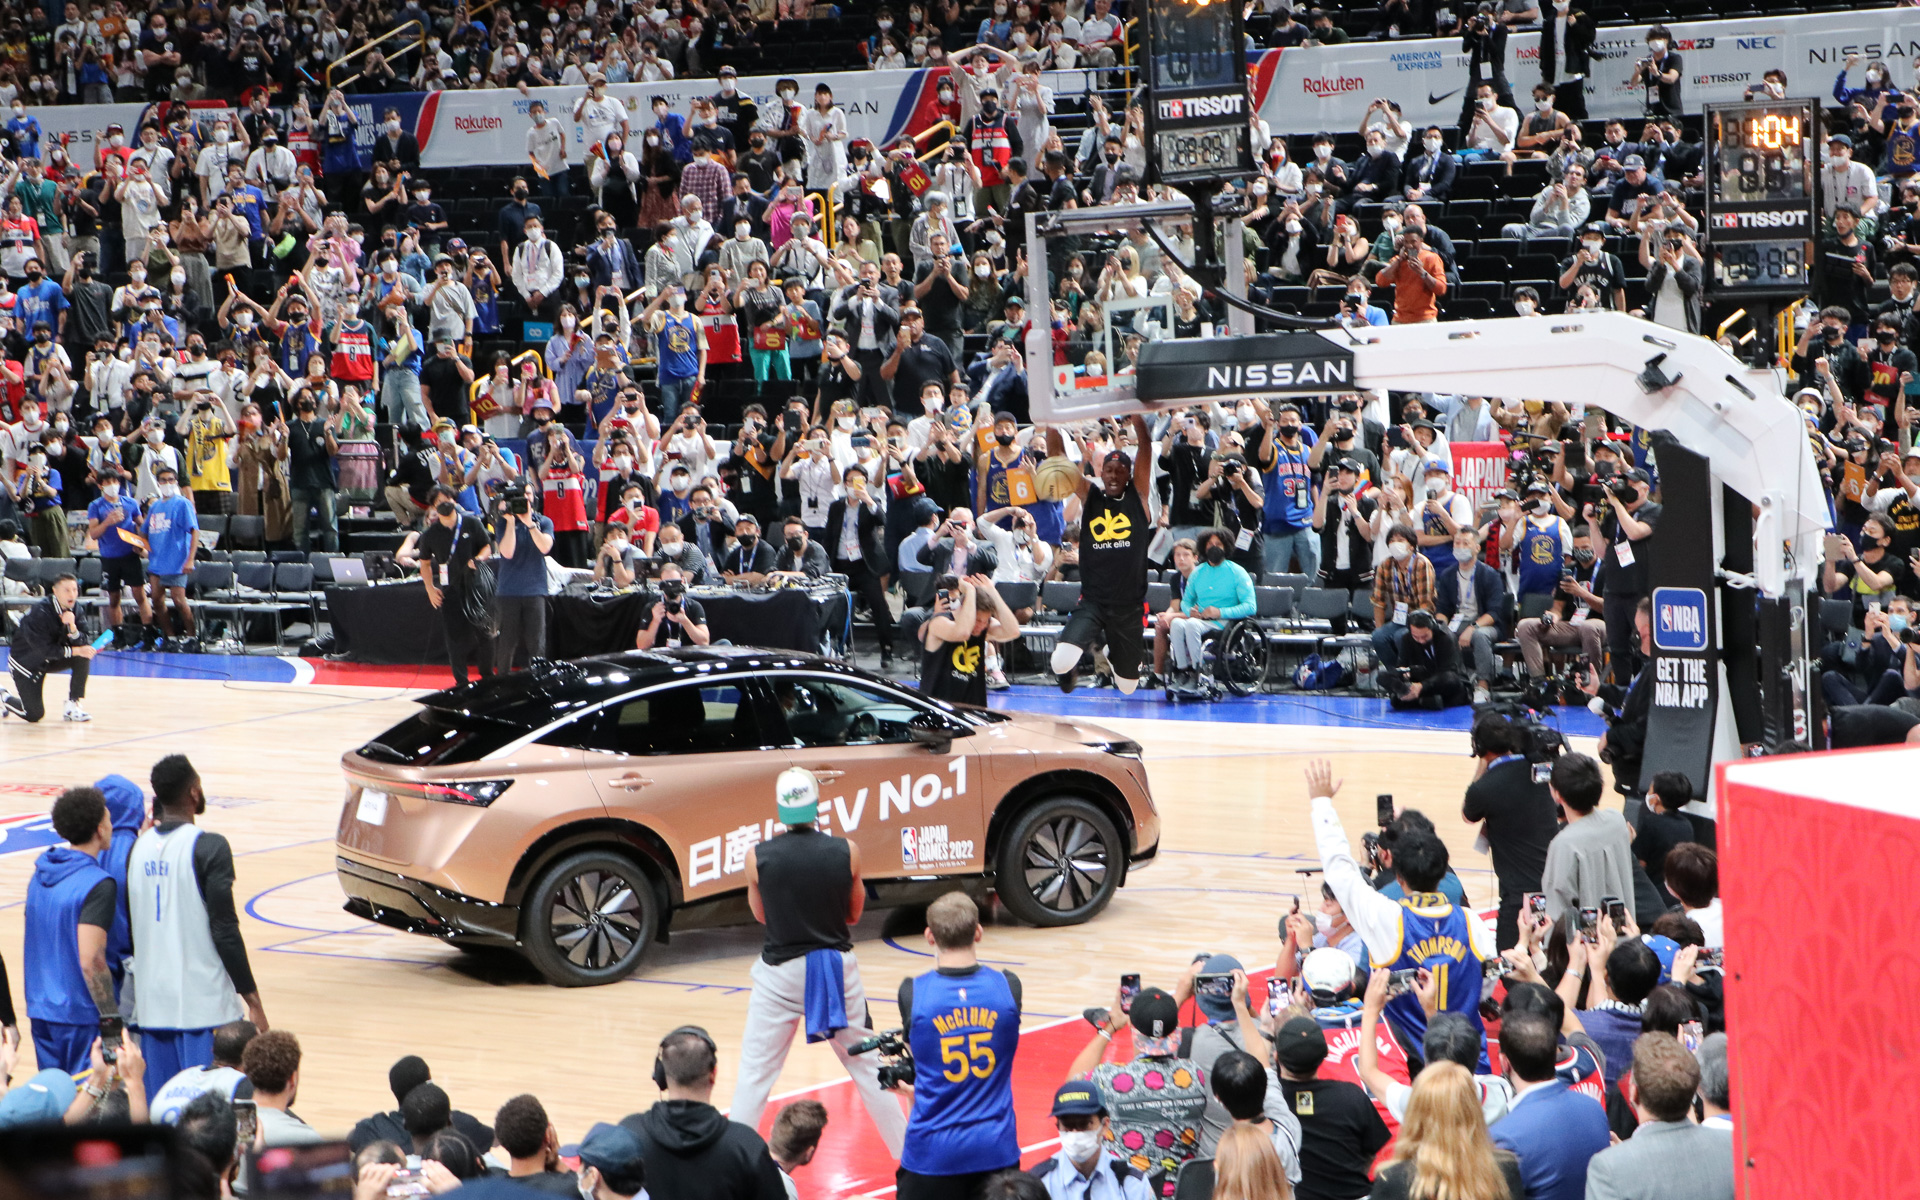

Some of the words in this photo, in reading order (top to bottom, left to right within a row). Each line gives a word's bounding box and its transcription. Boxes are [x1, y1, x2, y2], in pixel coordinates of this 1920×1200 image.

[1589, 39, 1637, 51] NSTYLE
[1736, 36, 1777, 50] NEC
[1390, 50, 1441, 62] AMERICAN
[1601, 50, 1628, 60] ROUP
[1397, 60, 1442, 72] EXPRESS
[1303, 75, 1364, 94] Rakuten
[1709, 72, 1752, 83] TISSOT
[1183, 93, 1244, 118] TISSOT
[454, 114, 503, 131] Rakuten
[1752, 115, 1800, 149] 1:04
[1737, 210, 1808, 228] TISSOT
[1208, 360, 1347, 389] NISSAN
[1455, 456, 1506, 488] JAPAN
[1015, 481, 1029, 499] 6
[1850, 477, 1861, 497] 6
[1089, 508, 1132, 542] de
[1092, 541, 1113, 550] dunk
[1113, 540, 1131, 549] elite
[1673, 604, 1701, 633] NBA
[1656, 656, 1680, 682] GET
[1681, 658, 1708, 684] THE
[1654, 681, 1681, 708] NBA
[1680, 683, 1709, 709] APP
[879, 755, 967, 821] No.1
[917, 824, 949, 844] JAPAN
[918, 842, 949, 863] GAMES
[948, 839, 975, 860] 2022
[1431, 962, 1449, 1011] 11
[940, 1032, 997, 1083] 55
